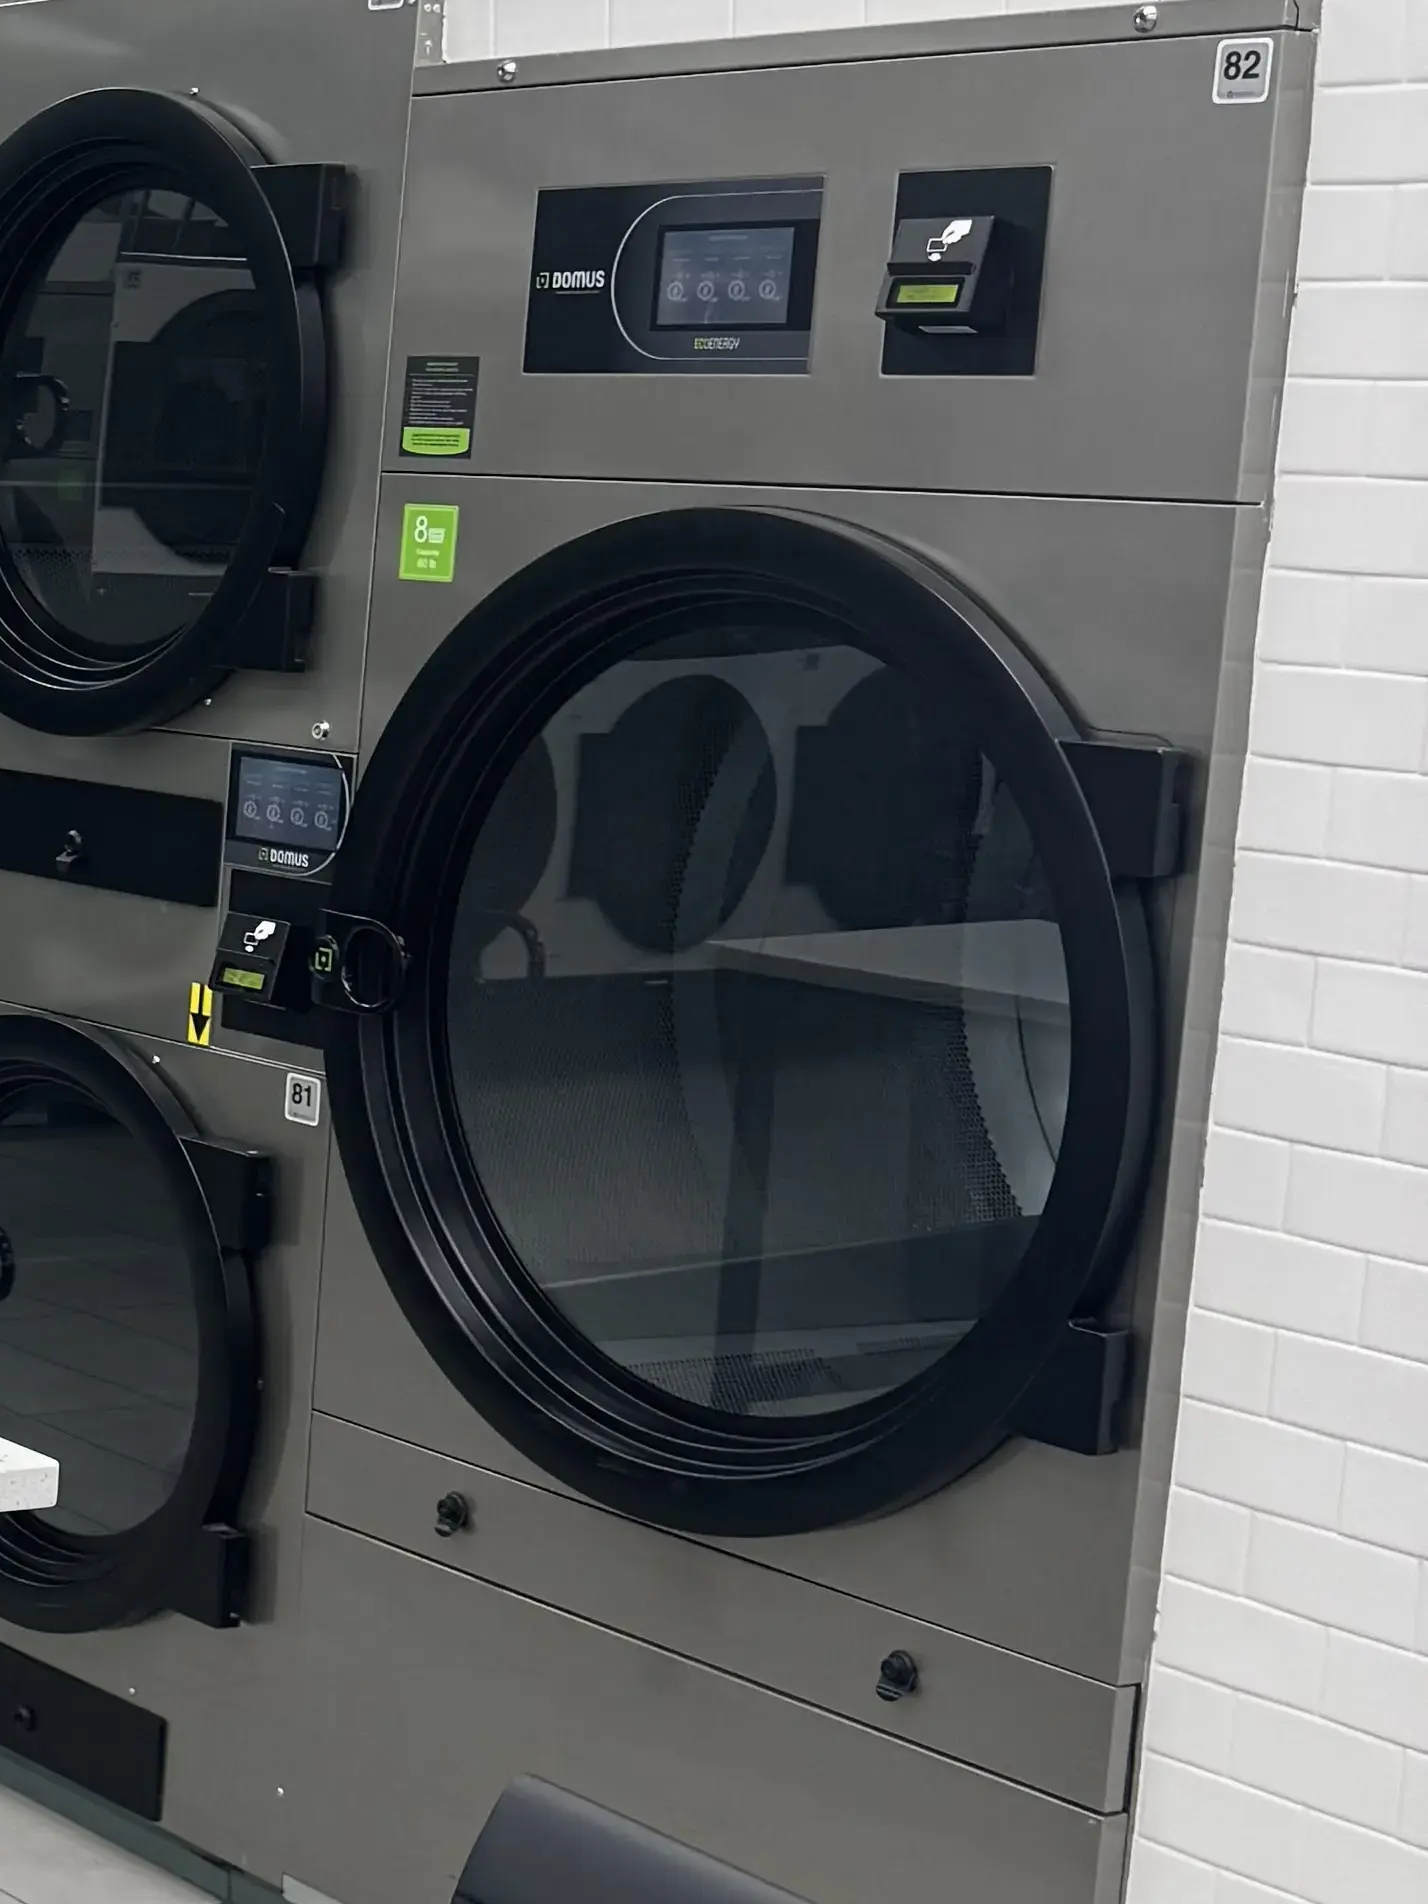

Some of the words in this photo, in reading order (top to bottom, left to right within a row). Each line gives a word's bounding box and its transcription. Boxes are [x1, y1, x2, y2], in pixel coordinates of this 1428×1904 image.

[1224, 50, 1261, 80] 82
[552, 270, 605, 289] DOMUS
[414, 515, 428, 543] 8
[270, 848, 309, 868] DOMUS
[291, 1083, 312, 1108] 81
